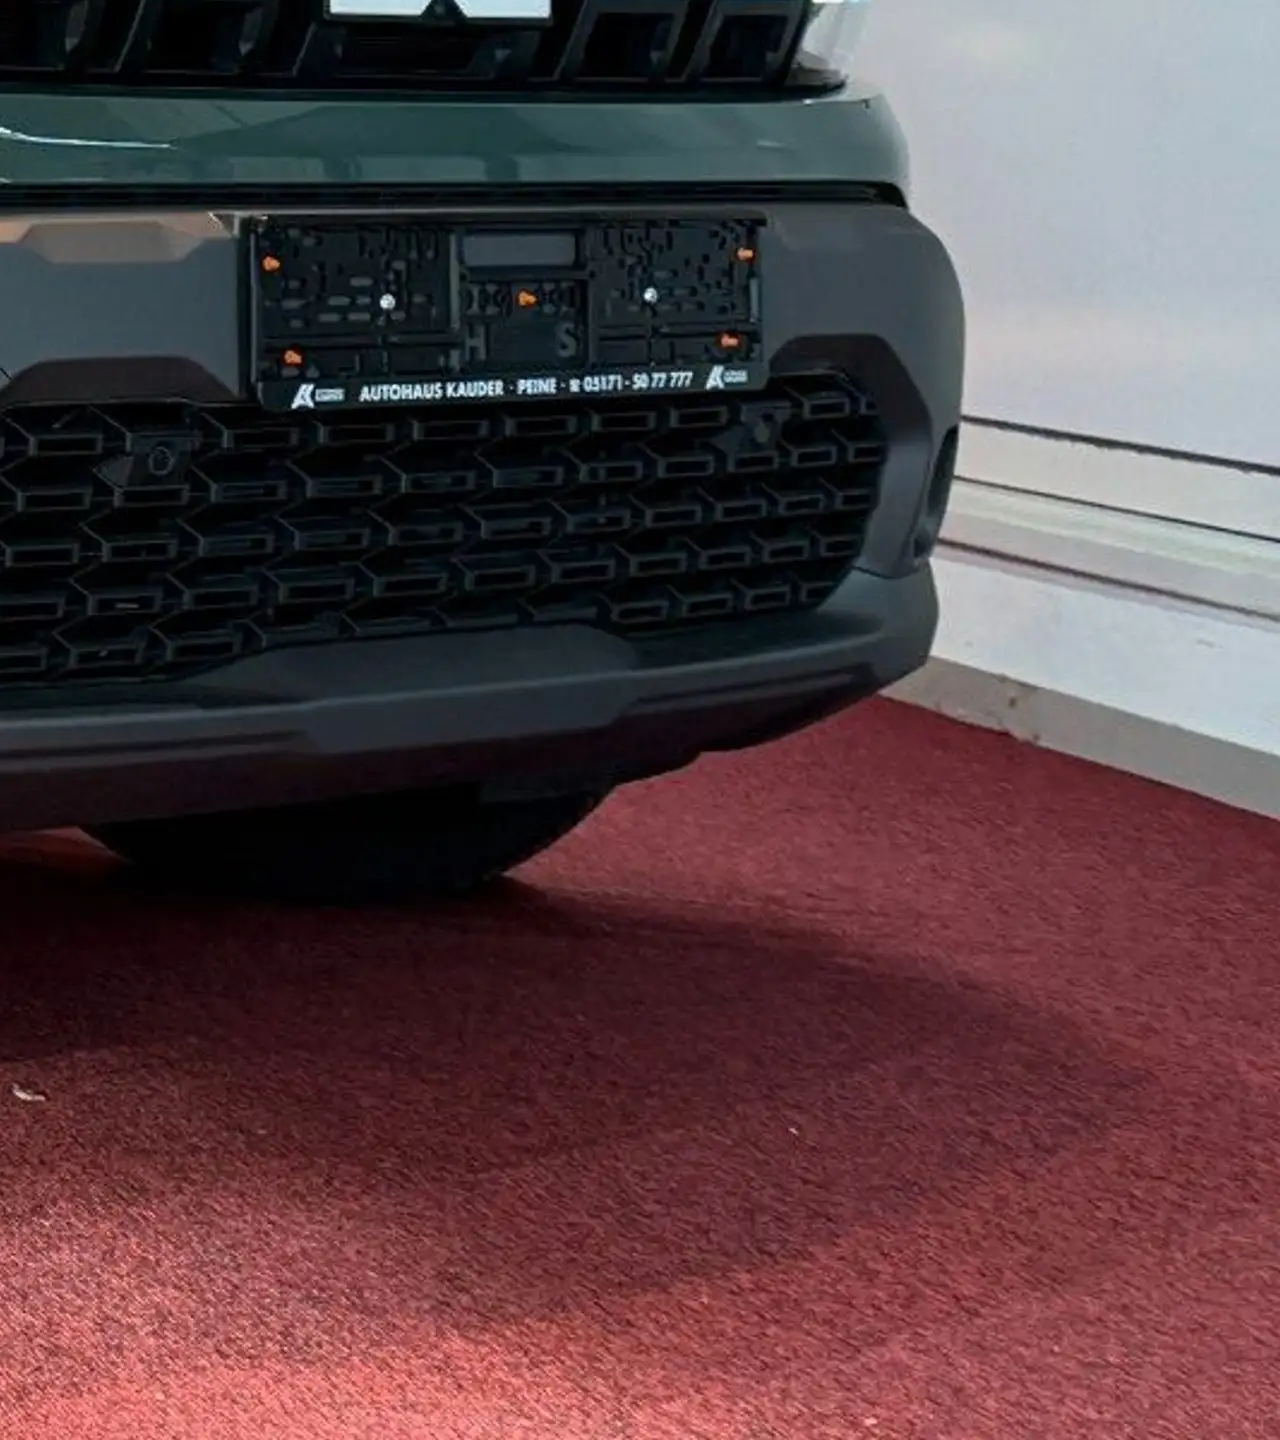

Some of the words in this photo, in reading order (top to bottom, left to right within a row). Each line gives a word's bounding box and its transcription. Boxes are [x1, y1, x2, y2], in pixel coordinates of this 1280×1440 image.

[358, 382, 443, 402] AUTOHAUS
[446, 379, 505, 398] KAUDER
[516, 377, 557, 395] PEINE
